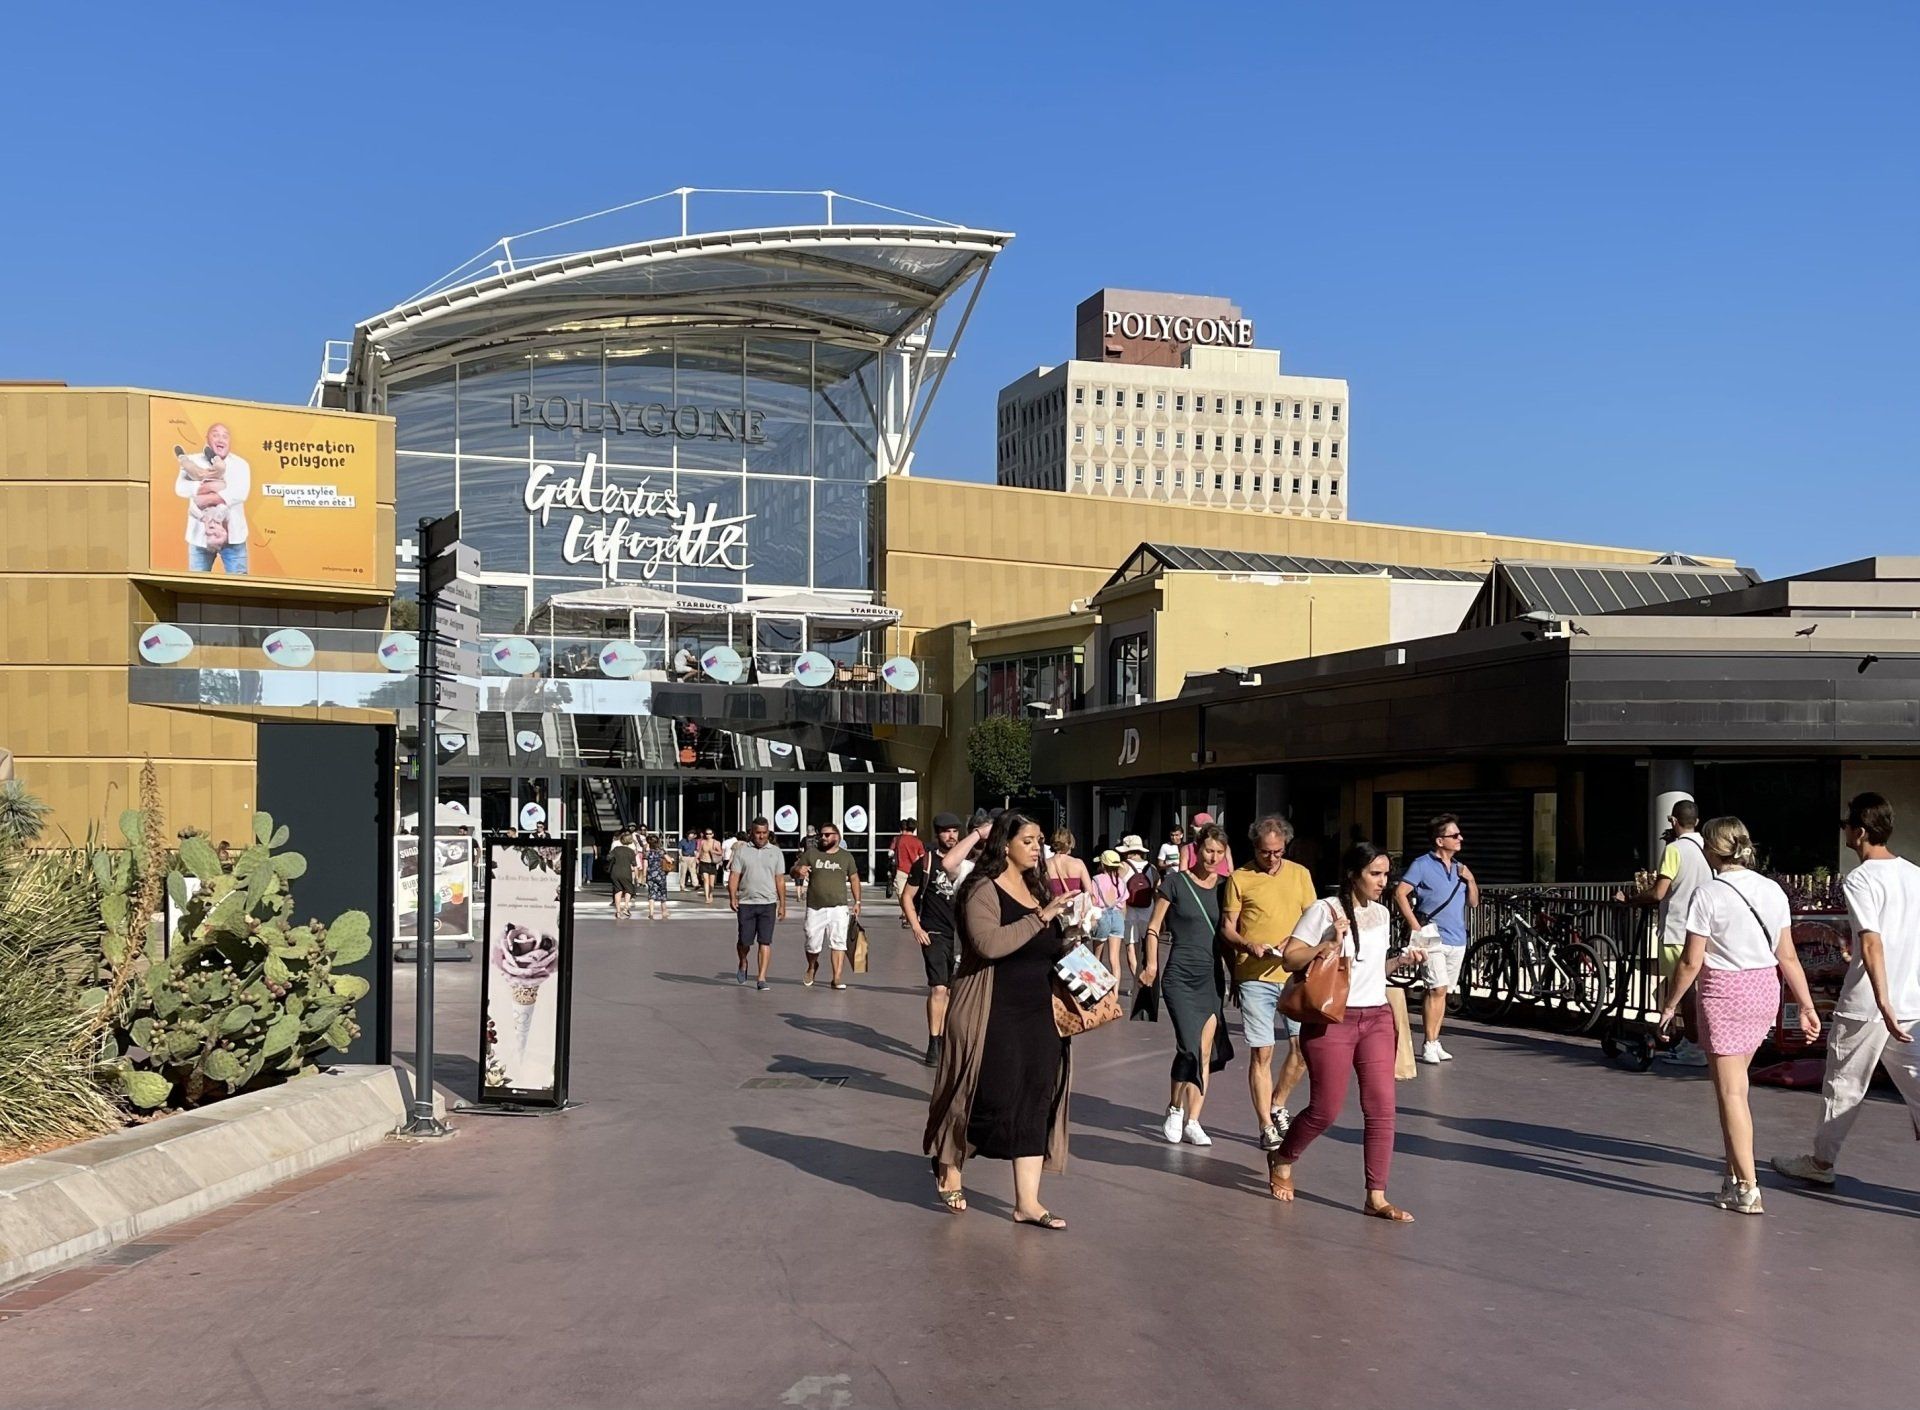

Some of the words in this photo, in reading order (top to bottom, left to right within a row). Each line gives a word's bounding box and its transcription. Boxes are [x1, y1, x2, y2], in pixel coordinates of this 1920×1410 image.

[1104, 311, 1254, 346] POLYGONE
[511, 393, 768, 444] POLYGONE
[262, 440, 355, 454] #generation
[280, 454, 346, 469] polygone
[265, 485, 305, 497] Toujours
[307, 487, 334, 498] stylée
[524, 452, 684, 527] Galeries
[287, 497, 316, 506] même
[332, 497, 347, 506] été
[562, 502, 757, 579] Lafayette
[676, 601, 728, 610] STARBUCKS
[850, 607, 899, 616] STARBUCKS
[1118, 728, 1140, 766] JD
